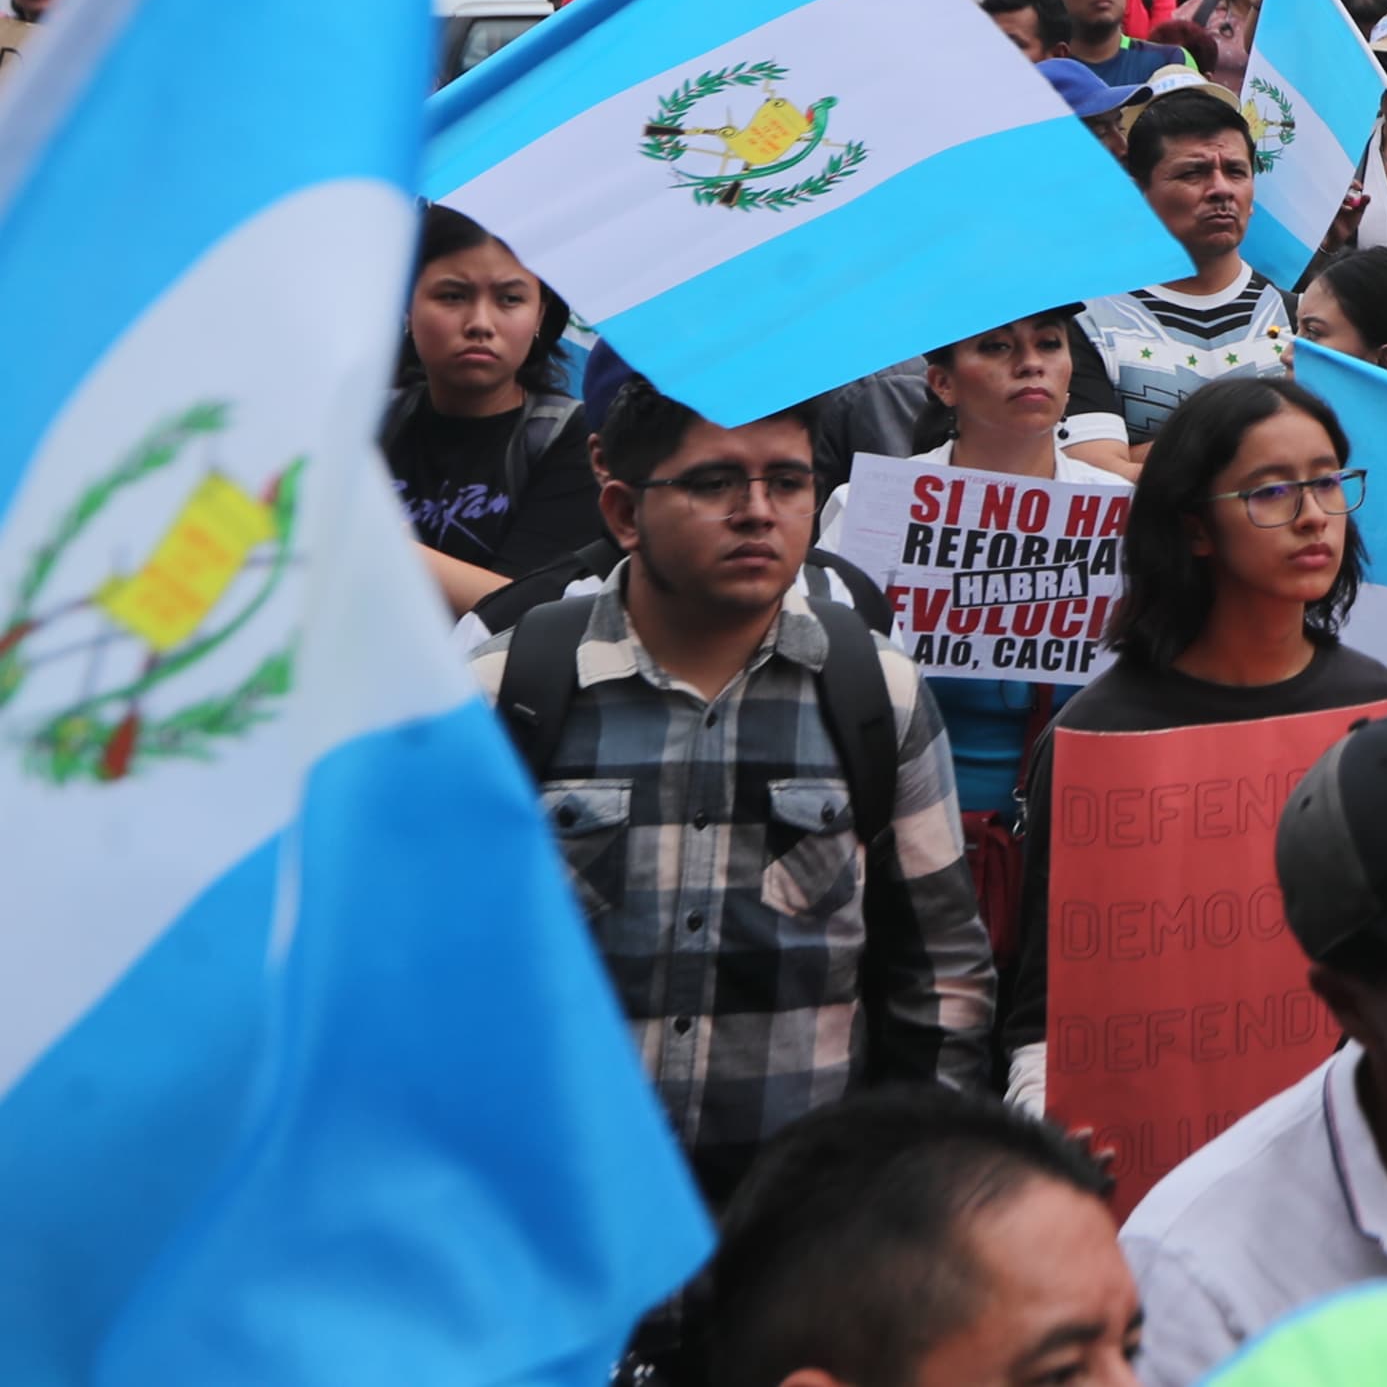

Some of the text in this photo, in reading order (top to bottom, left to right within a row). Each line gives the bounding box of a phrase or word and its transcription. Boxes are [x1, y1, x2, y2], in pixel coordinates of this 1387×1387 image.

[910, 474, 966, 526] SI
[978, 483, 1050, 533] NO
[958, 564, 1084, 606] HABRÁ
